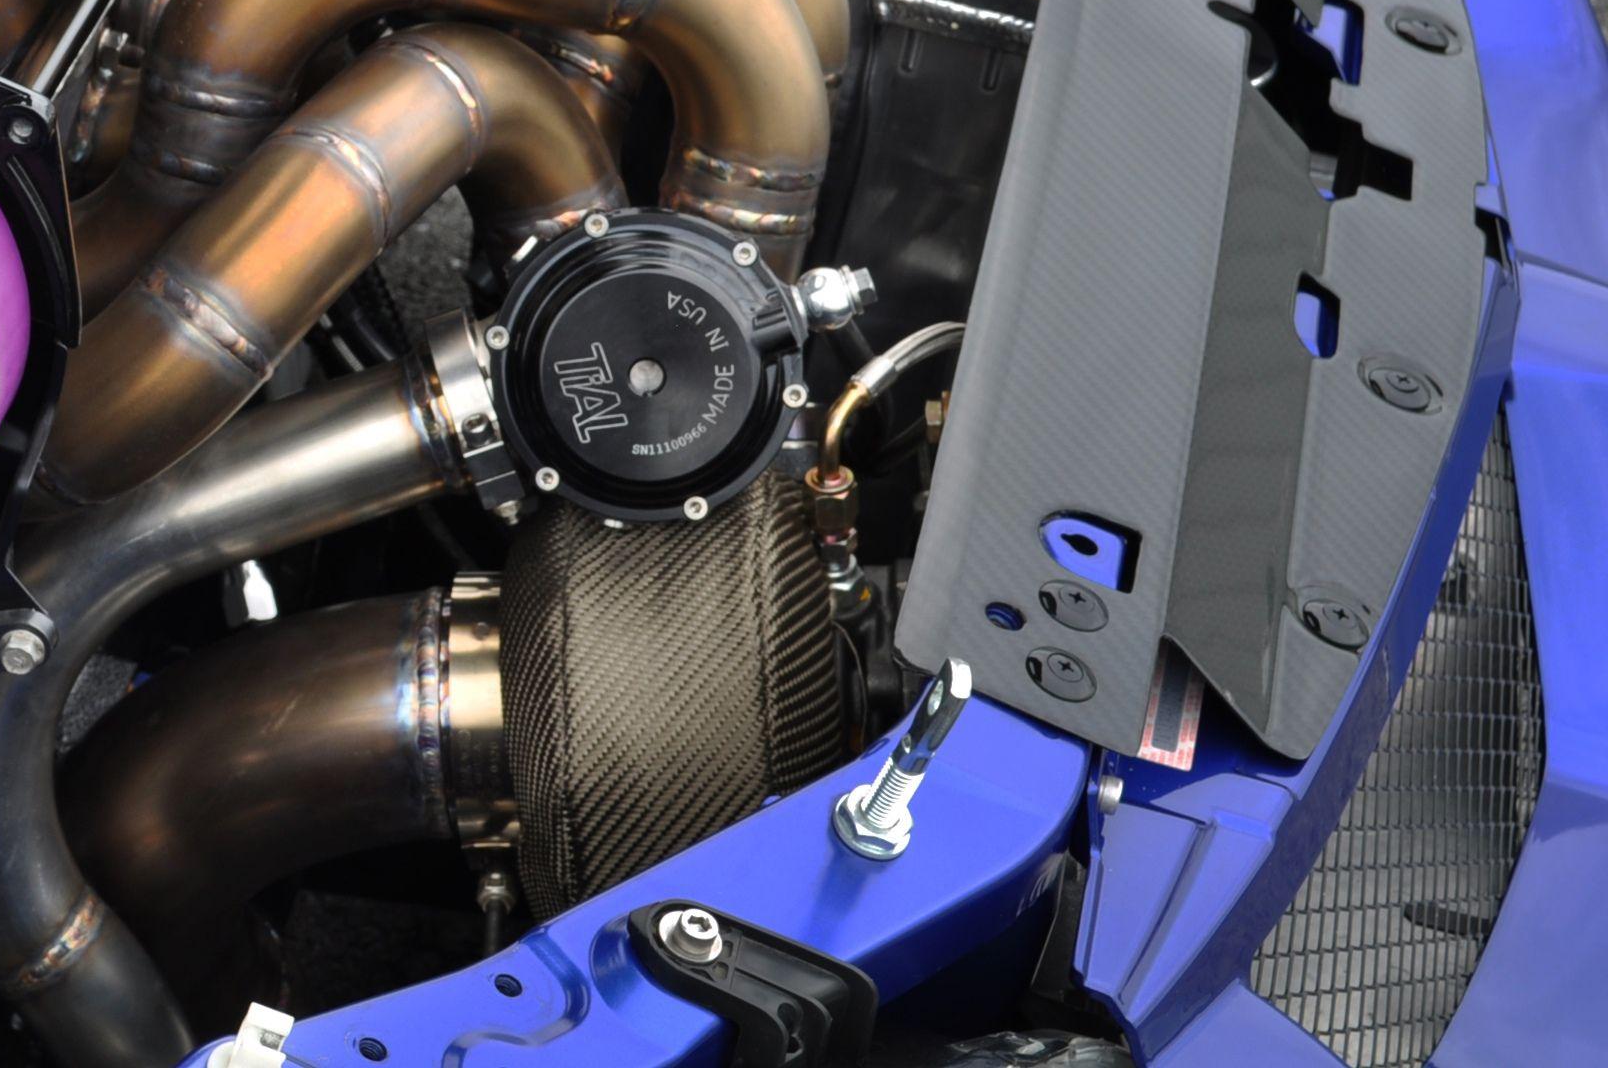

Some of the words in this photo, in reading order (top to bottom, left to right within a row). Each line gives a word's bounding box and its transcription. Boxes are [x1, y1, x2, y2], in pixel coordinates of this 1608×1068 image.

[667, 290, 707, 325] USA
[705, 327, 730, 352] IN
[702, 364, 734, 424] MADE
[631, 422, 708, 455] SN11100966
